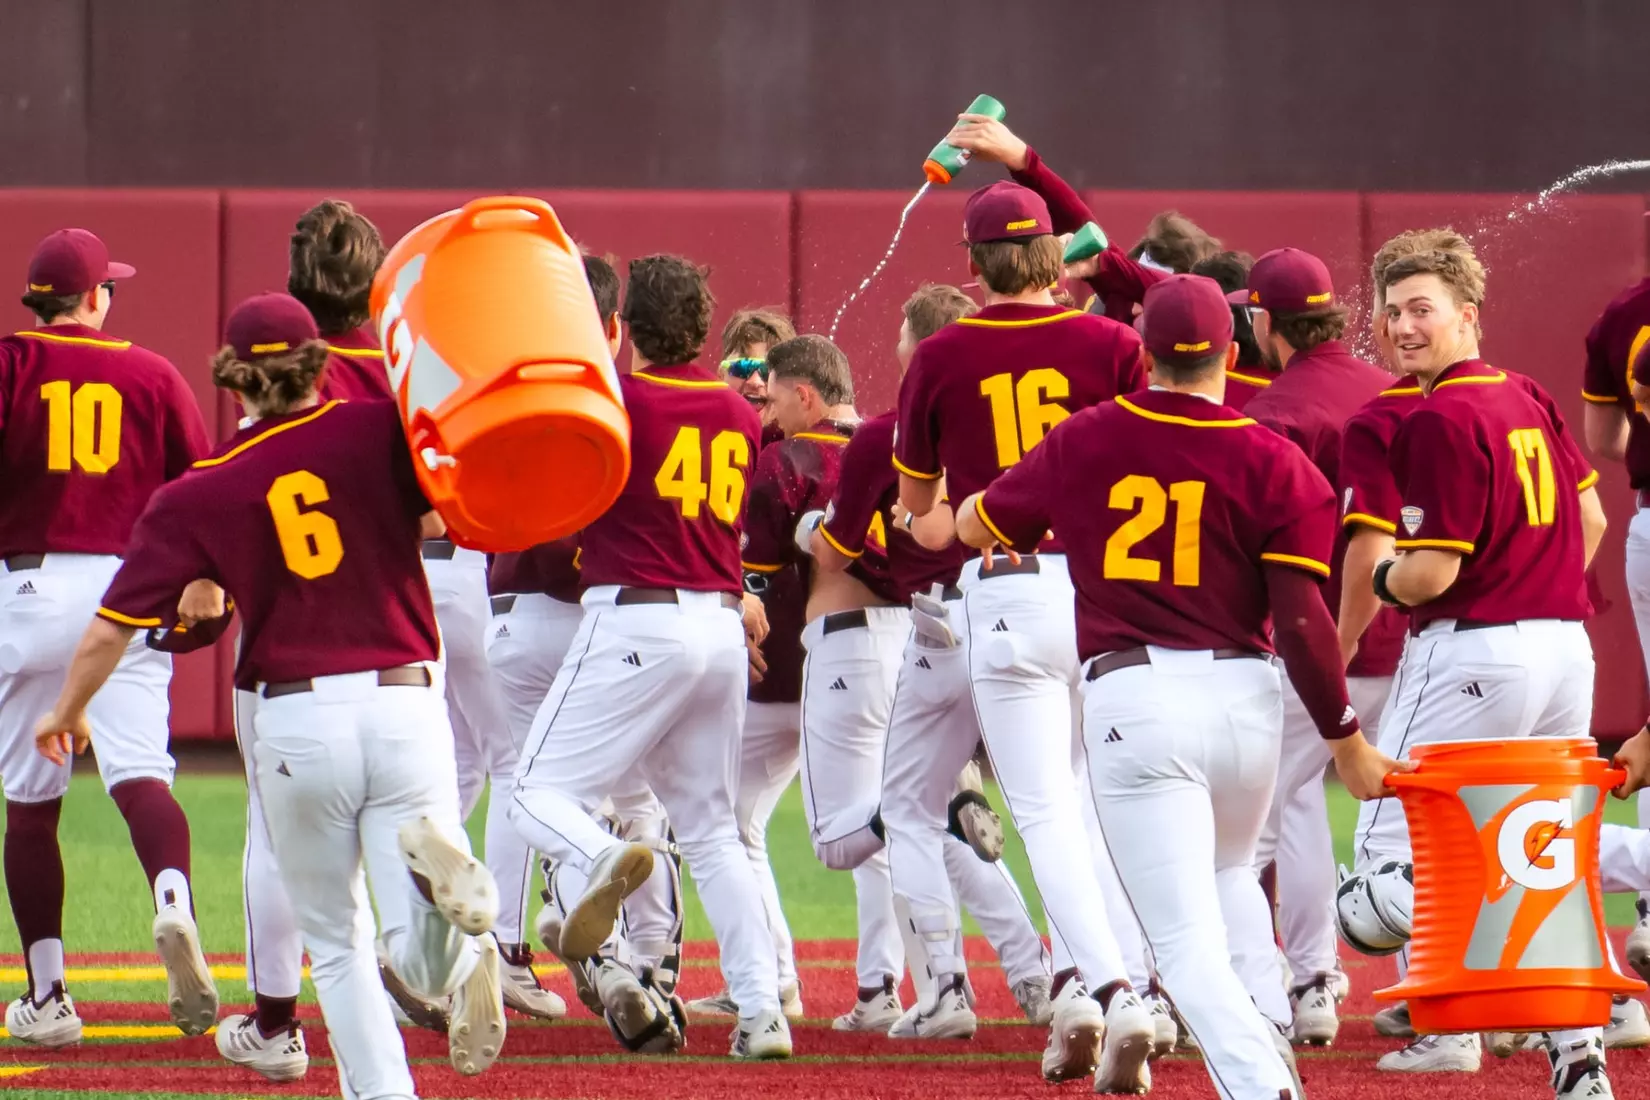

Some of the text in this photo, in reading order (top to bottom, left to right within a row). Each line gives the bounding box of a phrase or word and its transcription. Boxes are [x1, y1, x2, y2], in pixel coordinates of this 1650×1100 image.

[40, 380, 123, 474] 10
[980, 367, 1072, 468] 16
[266, 469, 344, 580] 6
[654, 425, 749, 525] 46
[1507, 427, 1556, 527] 17
[1103, 474, 1206, 587] 21
[1497, 797, 1576, 891] G
